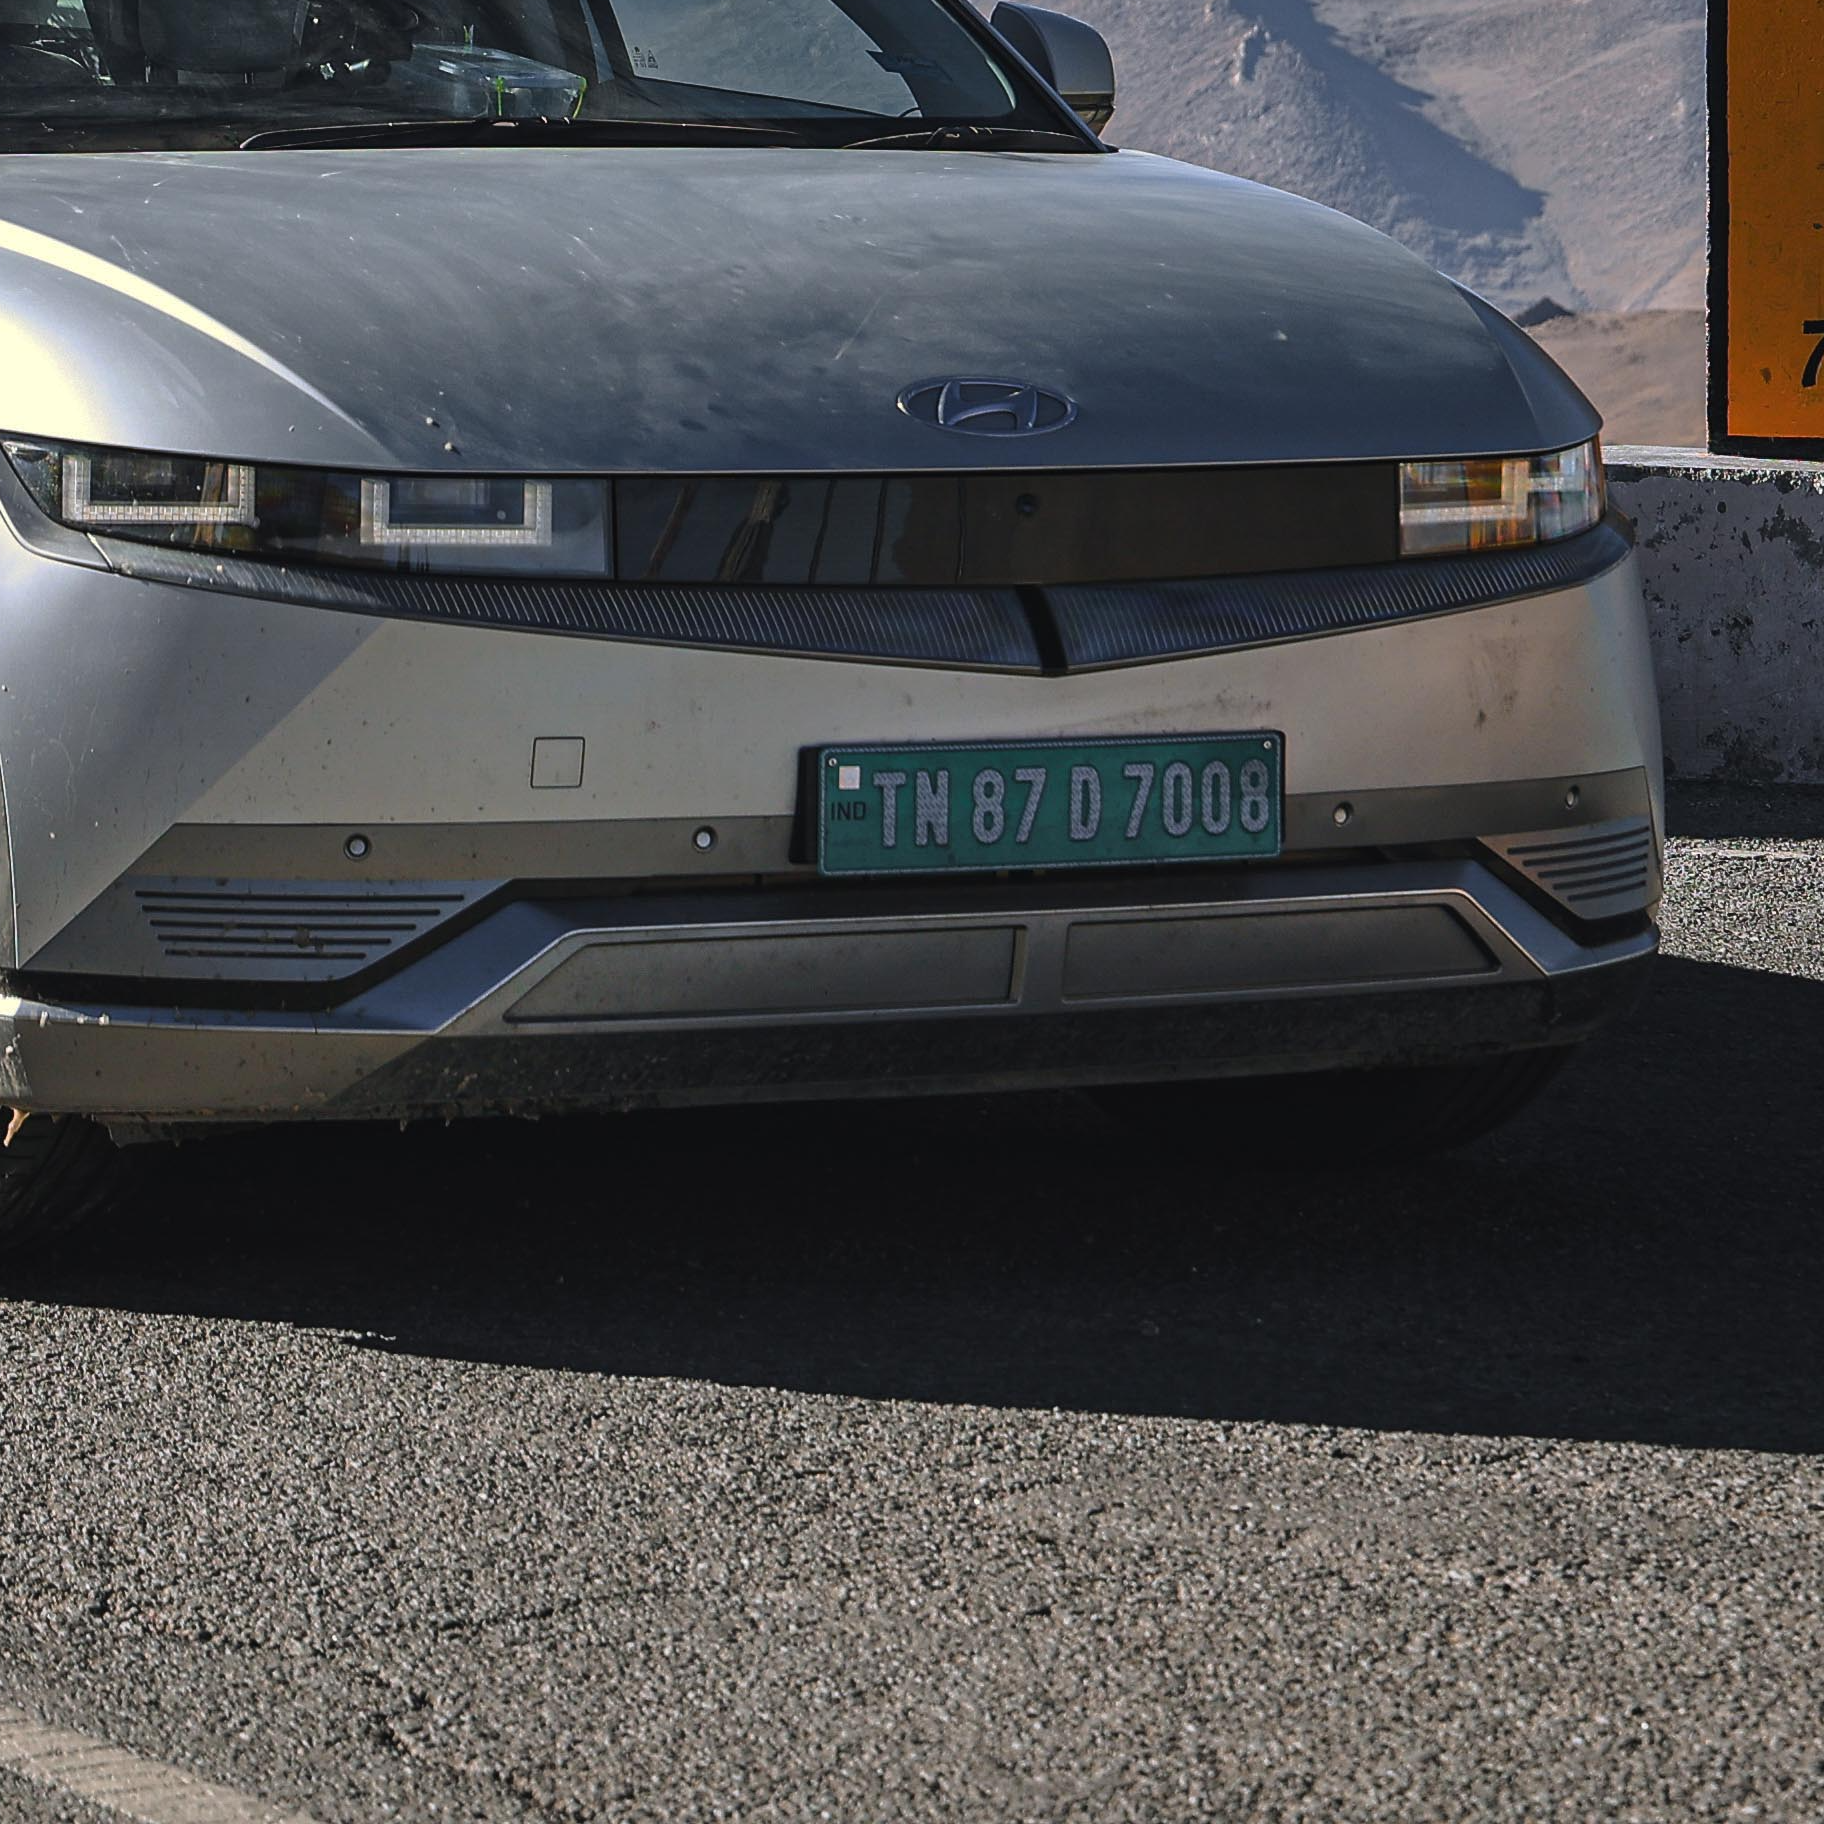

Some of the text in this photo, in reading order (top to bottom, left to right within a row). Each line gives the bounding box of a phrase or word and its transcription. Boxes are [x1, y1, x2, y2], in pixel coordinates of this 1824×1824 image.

[830, 801, 868, 822] IND
[873, 758, 1271, 848] TN 87 D 7008
